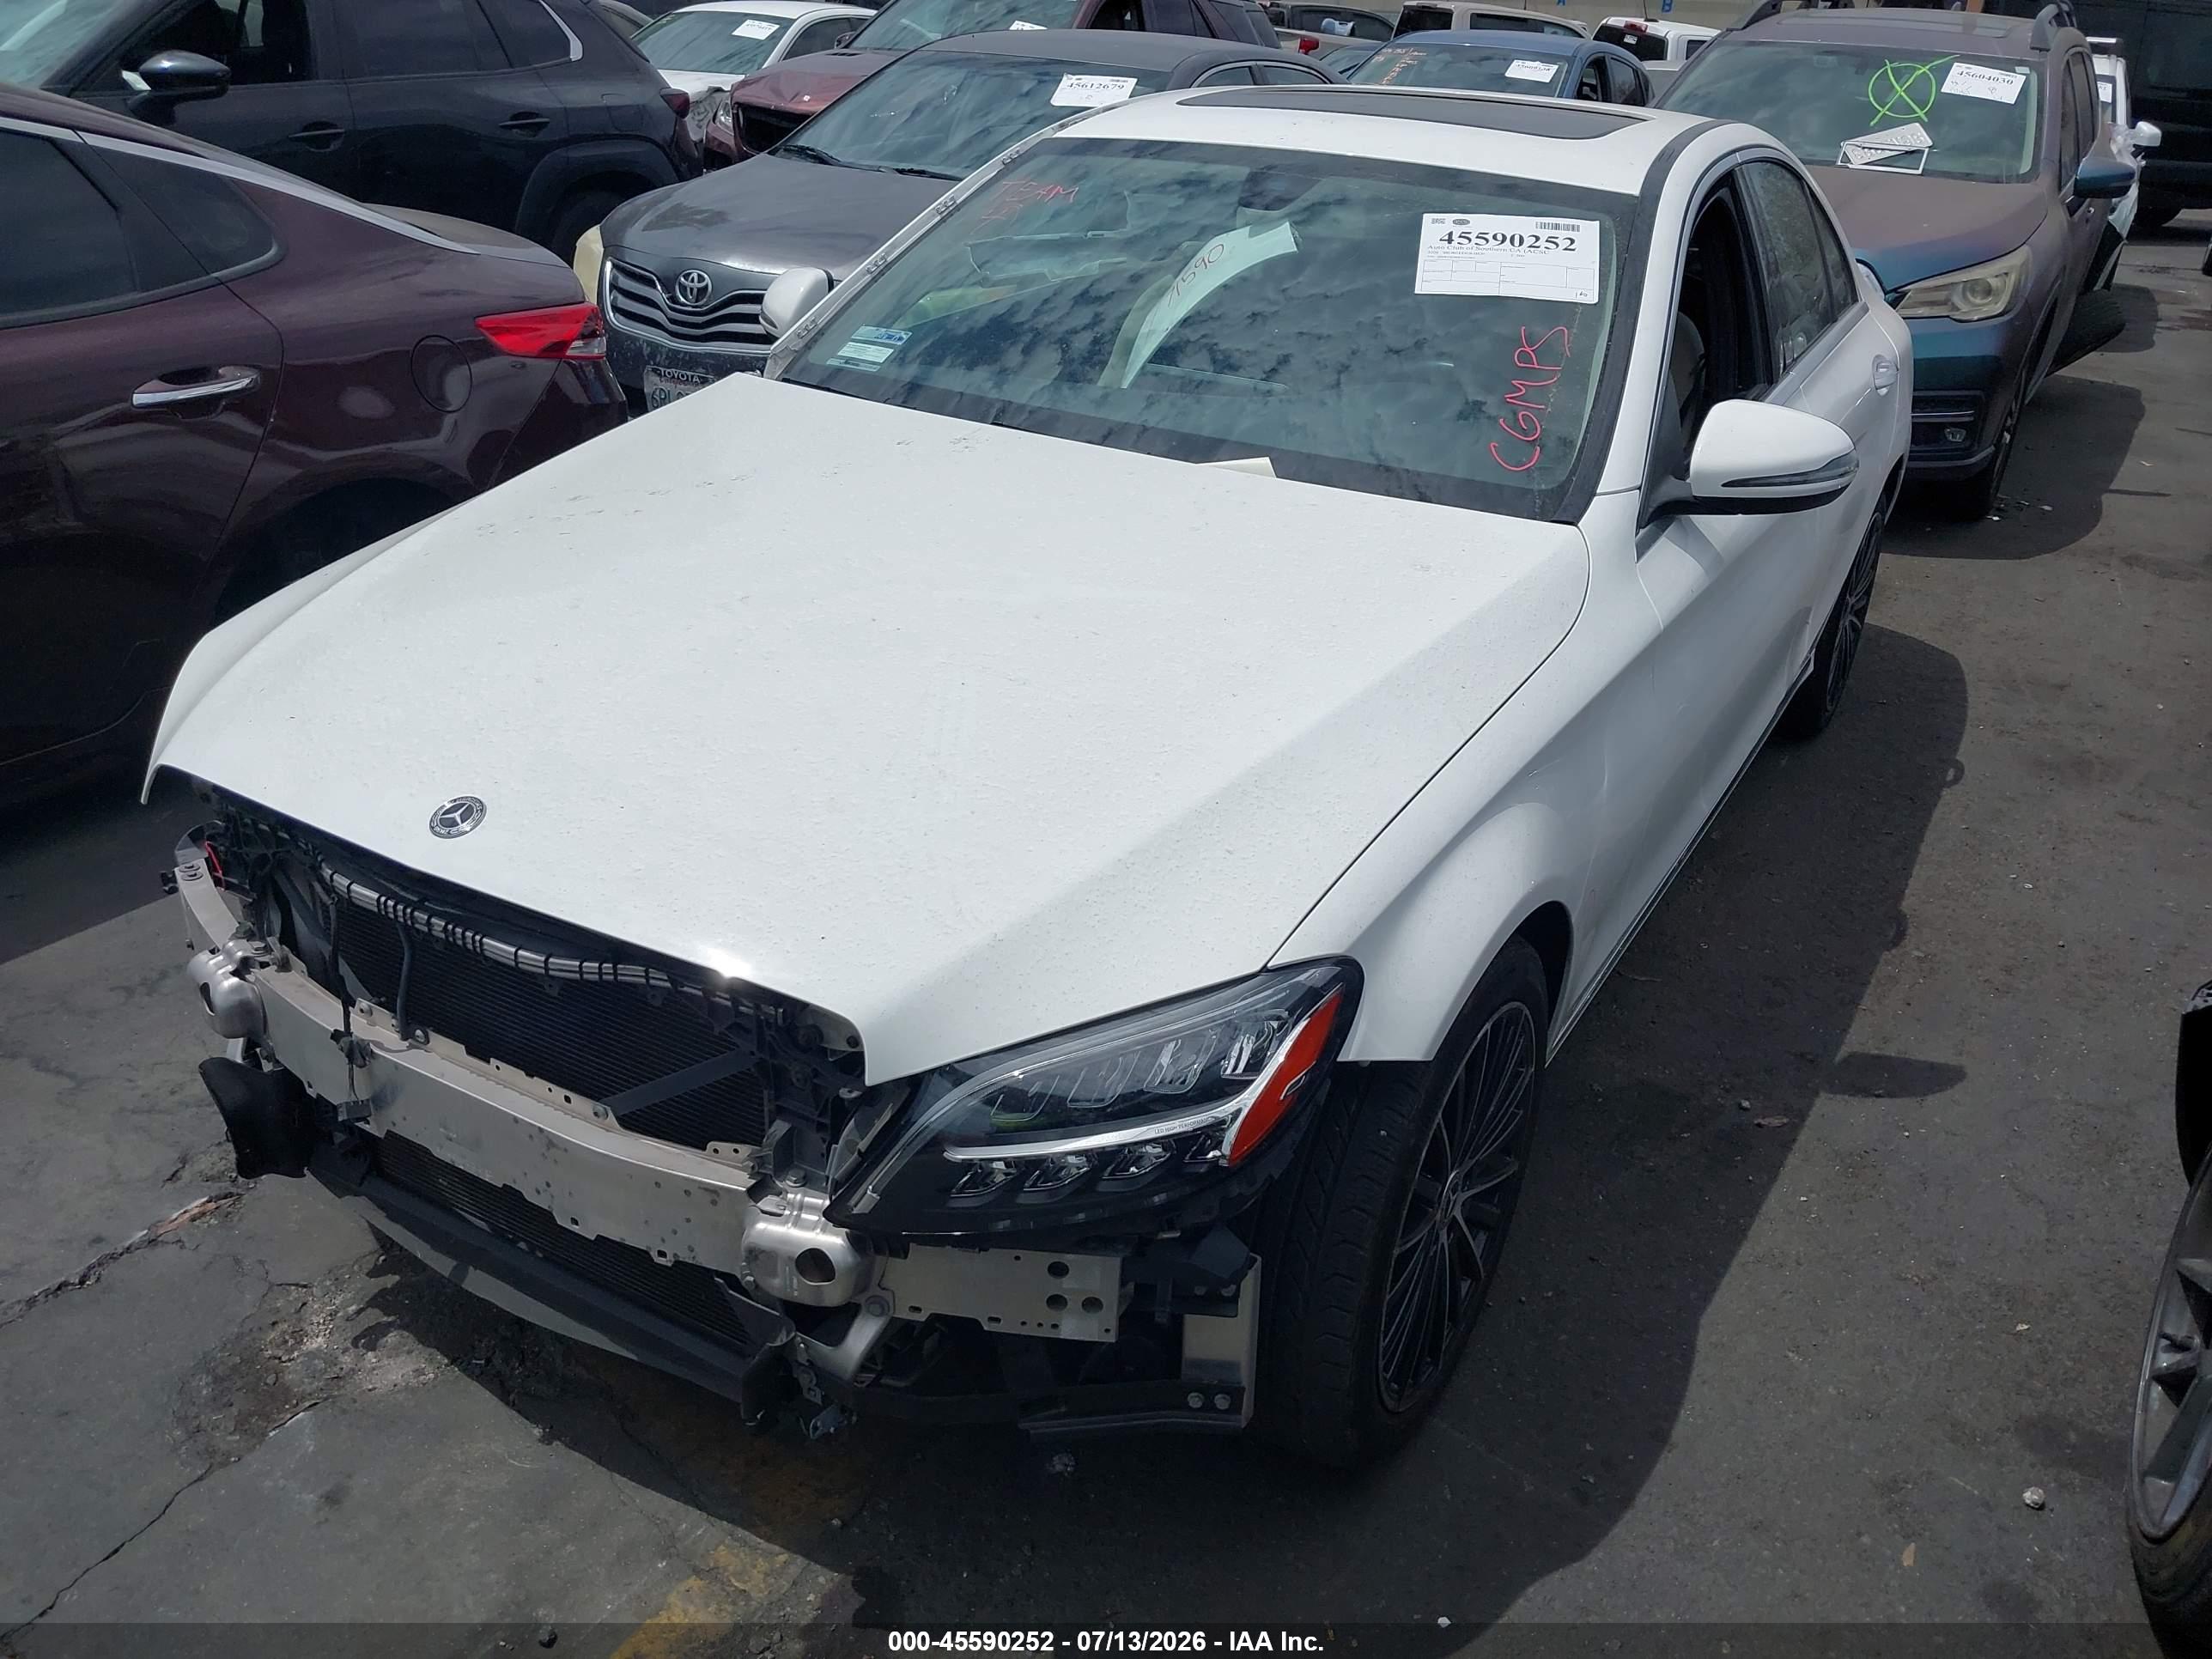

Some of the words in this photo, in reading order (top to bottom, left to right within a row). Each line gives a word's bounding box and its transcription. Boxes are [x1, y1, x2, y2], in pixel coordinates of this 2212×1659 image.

[1958, 70, 2014, 85] 45604030
[1438, 230, 1577, 252] 45590252
[659, 369, 701, 384] TOYOTA
